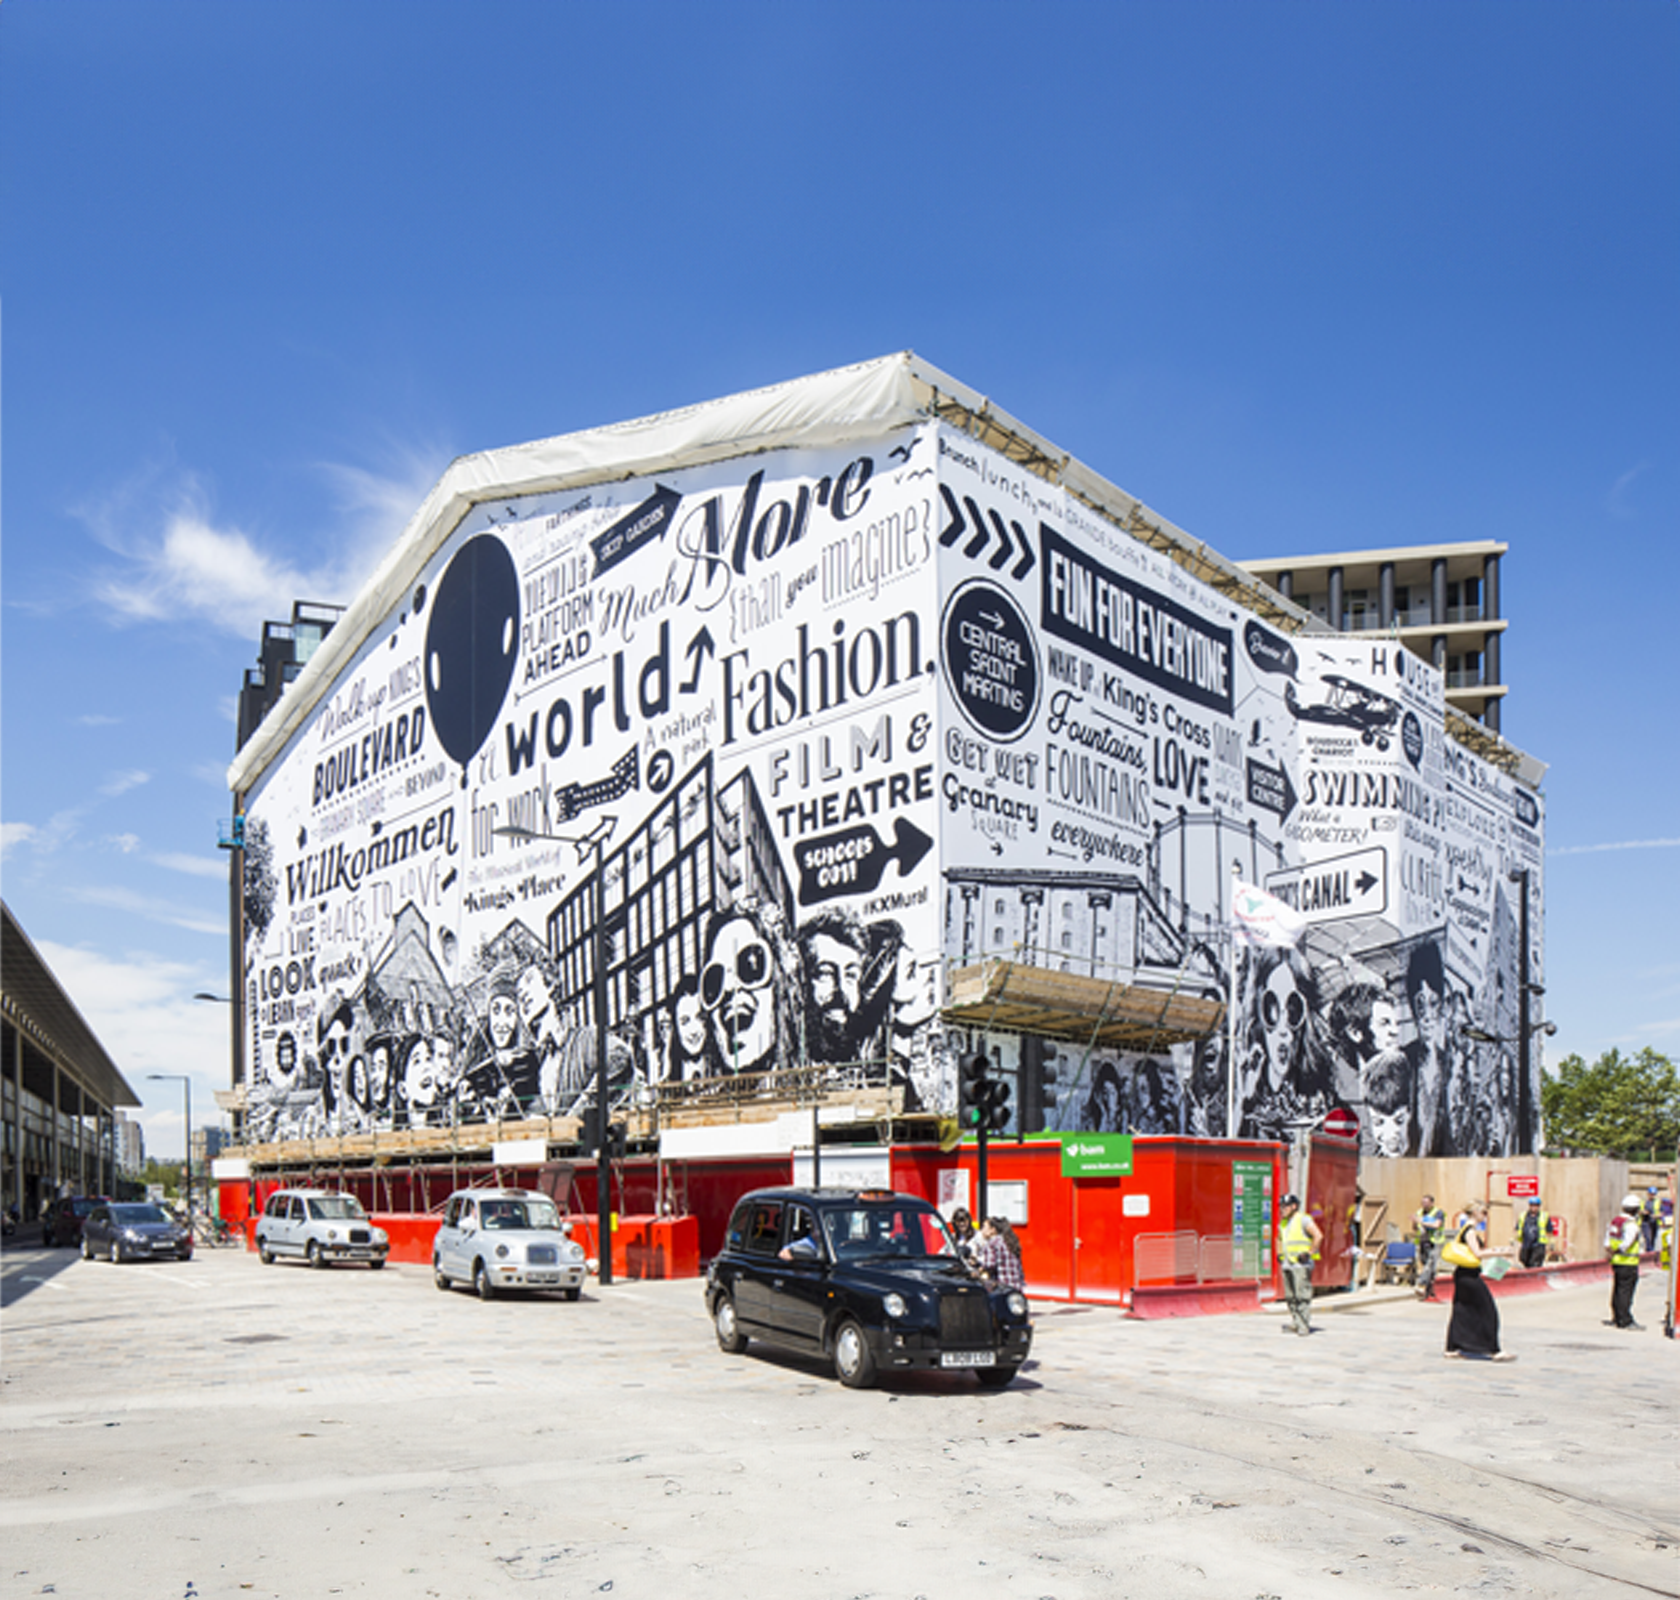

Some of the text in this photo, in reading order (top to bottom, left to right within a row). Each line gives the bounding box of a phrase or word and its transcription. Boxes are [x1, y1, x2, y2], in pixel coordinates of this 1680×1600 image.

[598, 557, 679, 643] Much
[677, 456, 874, 611] More
[786, 564, 817, 609] you
[522, 589, 593, 656] PLATFORM
[960, 620, 1027, 667] CENTRAL
[1051, 550, 1093, 634] FUN
[1097, 576, 1136, 656] FOR
[1138, 598, 1228, 697] EVERYONE
[524, 630, 591, 684] AHEAD
[970, 650, 1017, 684] SAINT
[506, 619, 670, 776] world
[963, 671, 1025, 712] MARTINS
[1103, 672, 1158, 725] King's
[1163, 704, 1210, 748] Cross
[312, 705, 425, 807] BOULEVARD
[643, 698, 716, 755] A natural
[769, 712, 932, 798] FILM &
[945, 727, 1039, 790] GET WET
[1046, 742, 1150, 829] FOUNTAINS
[1154, 737, 1210, 806] LOVE
[471, 788, 498, 859] for
[777, 763, 933, 838] THEATRE
[941, 772, 1039, 832] Granary
[286, 806, 459, 905] Willkommen
[818, 860, 858, 888] OUT!
[1051, 821, 1144, 867] everywhere
[370, 881, 393, 925] TO
[400, 855, 442, 907] LOVE
[517, 874, 566, 901] Place
[1302, 870, 1351, 912] CANAL
[260, 955, 316, 1001] LOOK
[1081, 1142, 1105, 1156] bam
